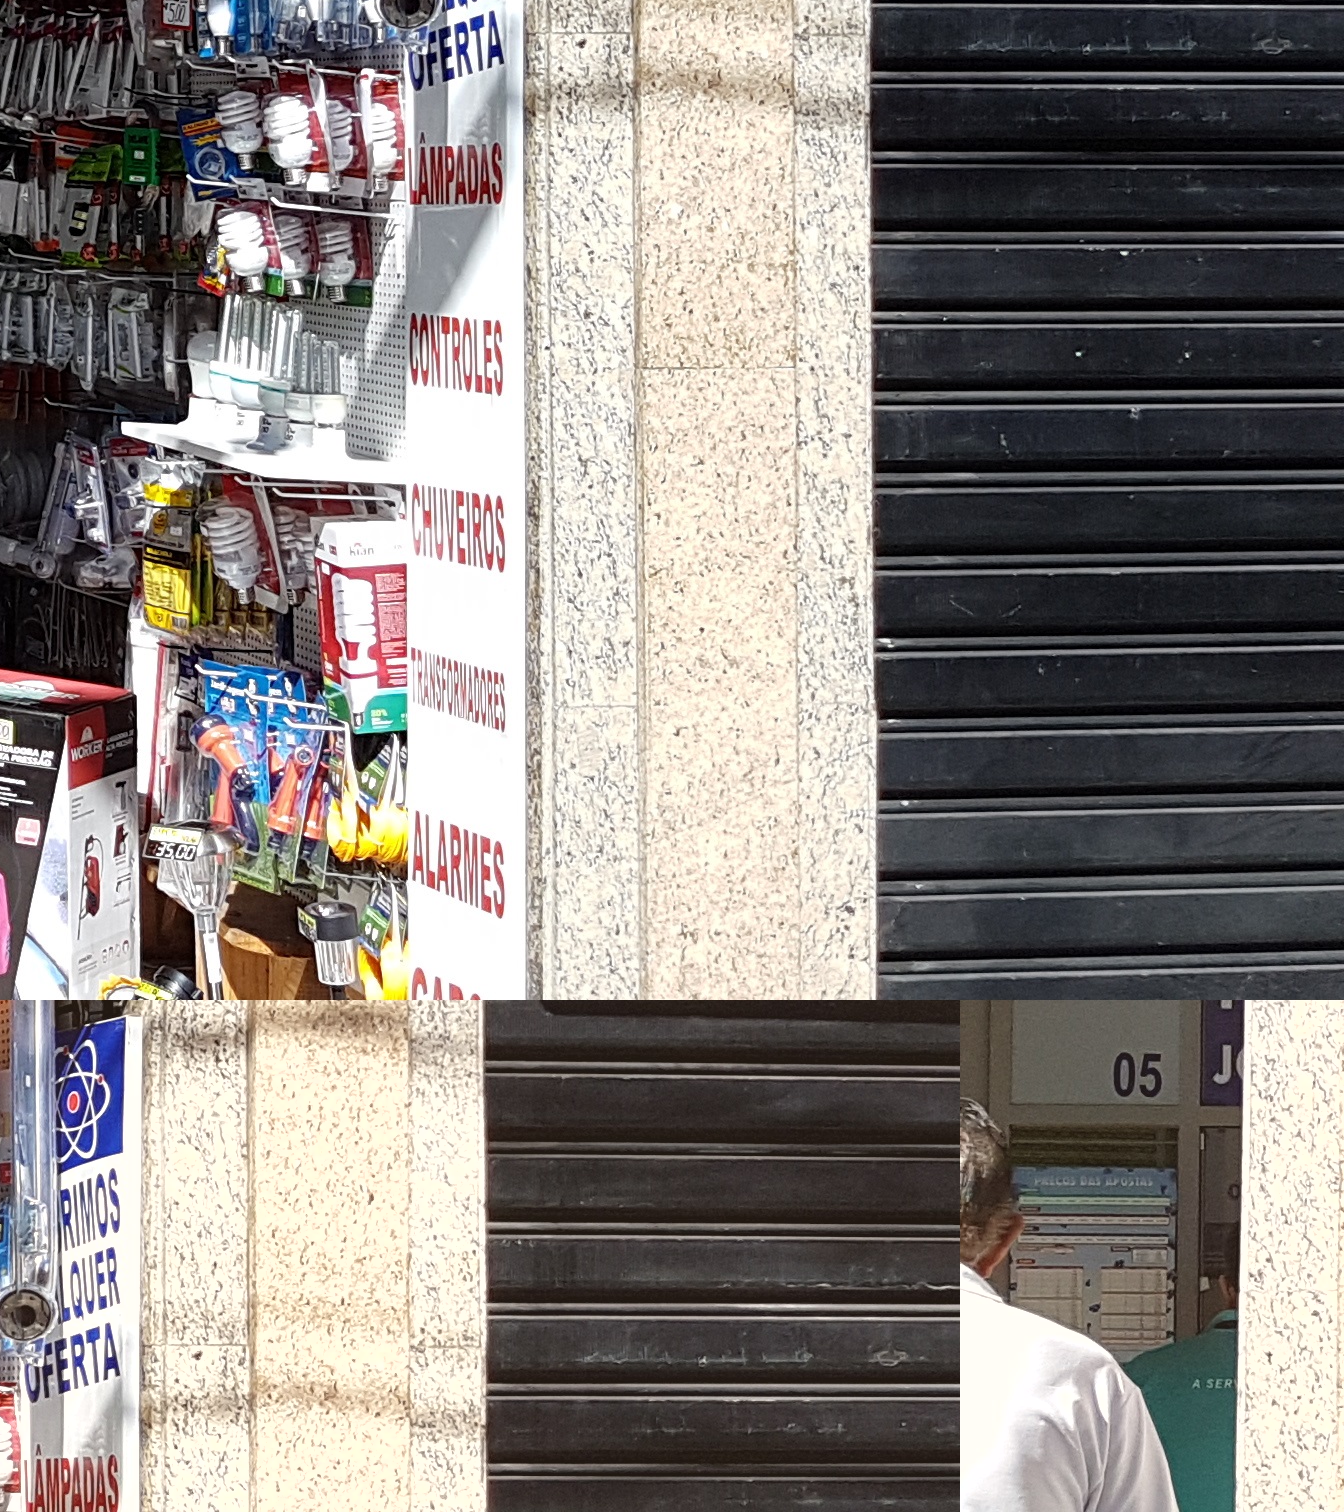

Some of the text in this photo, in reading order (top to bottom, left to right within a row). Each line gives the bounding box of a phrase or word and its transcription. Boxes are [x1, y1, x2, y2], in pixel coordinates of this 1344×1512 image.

[407, 10, 506, 92] OFERTA
[407, 133, 504, 207] LÂMPADAS
[409, 312, 504, 397] CONTROLES
[411, 484, 506, 574] CHUVEIROS
[410, 647, 506, 733] TRANSFORMADORES
[71, 739, 104, 762] WORKER
[413, 810, 505, 920] ALARMES
[1113, 1052, 1163, 1098] 05
[23, 1445, 120, 1512] LÂMPADAS
